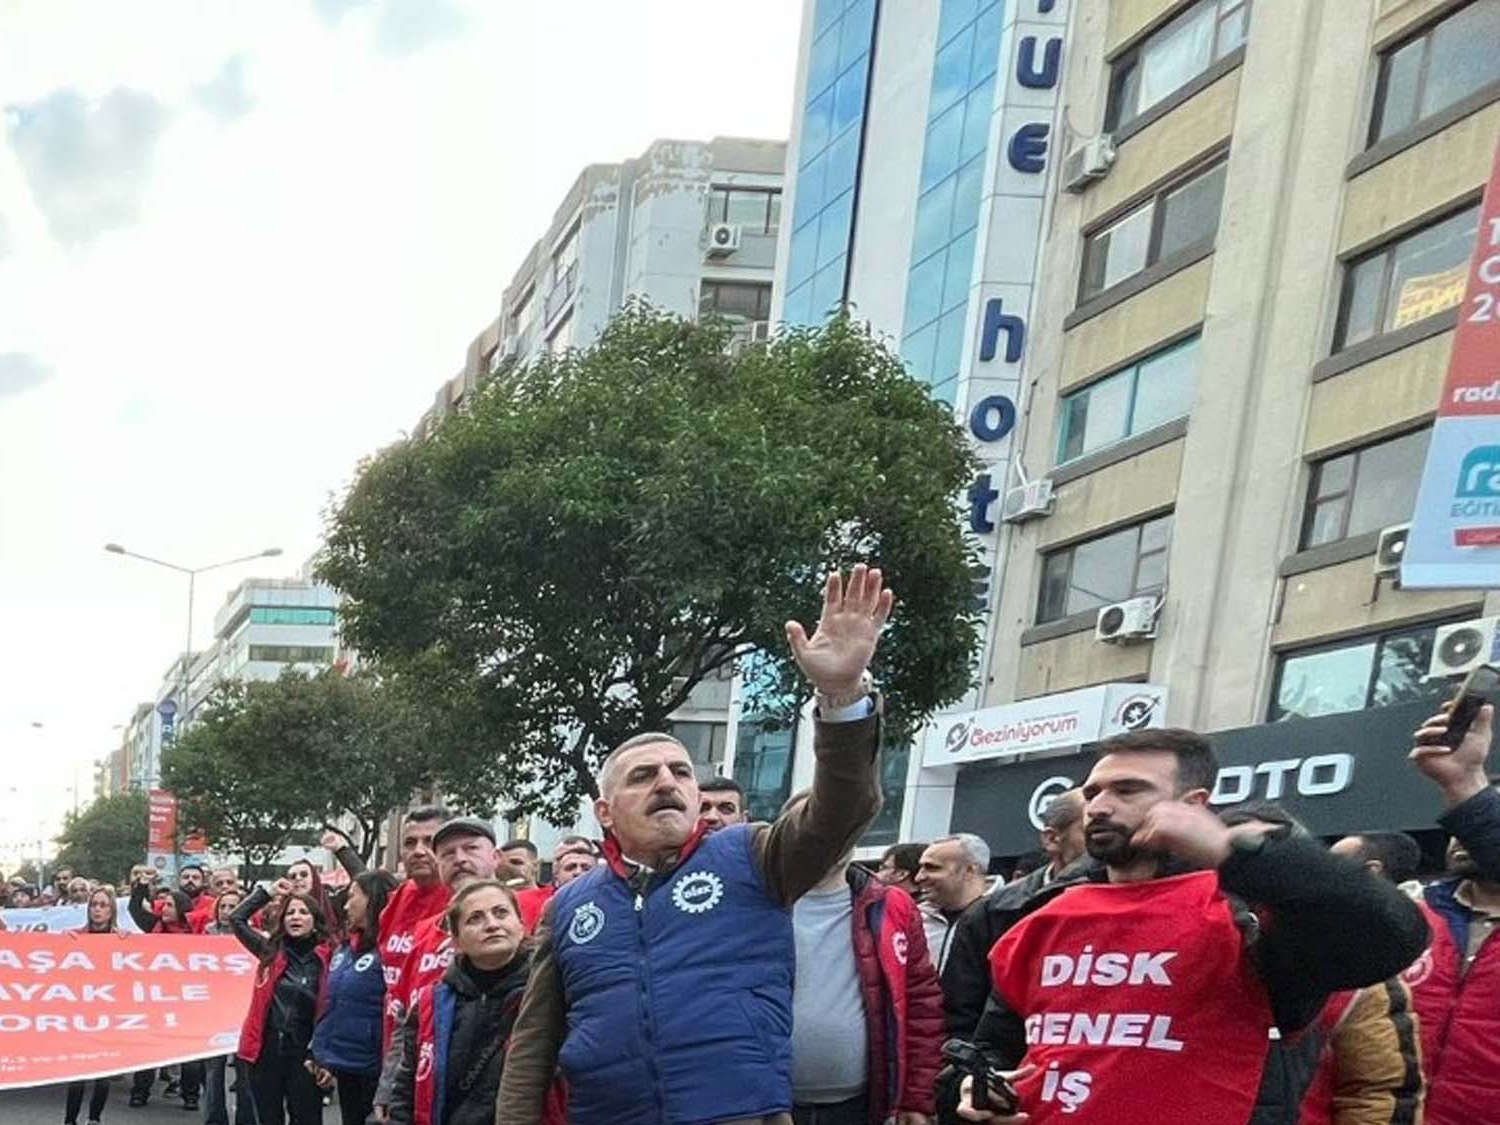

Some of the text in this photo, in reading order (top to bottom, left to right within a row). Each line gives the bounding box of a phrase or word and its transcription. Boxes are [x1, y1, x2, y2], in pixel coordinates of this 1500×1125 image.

[970, 716, 1077, 746] Geziniyorum
[386, 932, 414, 953] DİS
[110, 951, 252, 976] KARŞ
[418, 947, 454, 973] DİS
[1041, 945, 1178, 987] DİSK
[132, 979, 211, 1003] İLE
[1024, 1012, 1185, 1052] GENEL
[1040, 1060, 1093, 1114] İŞ
